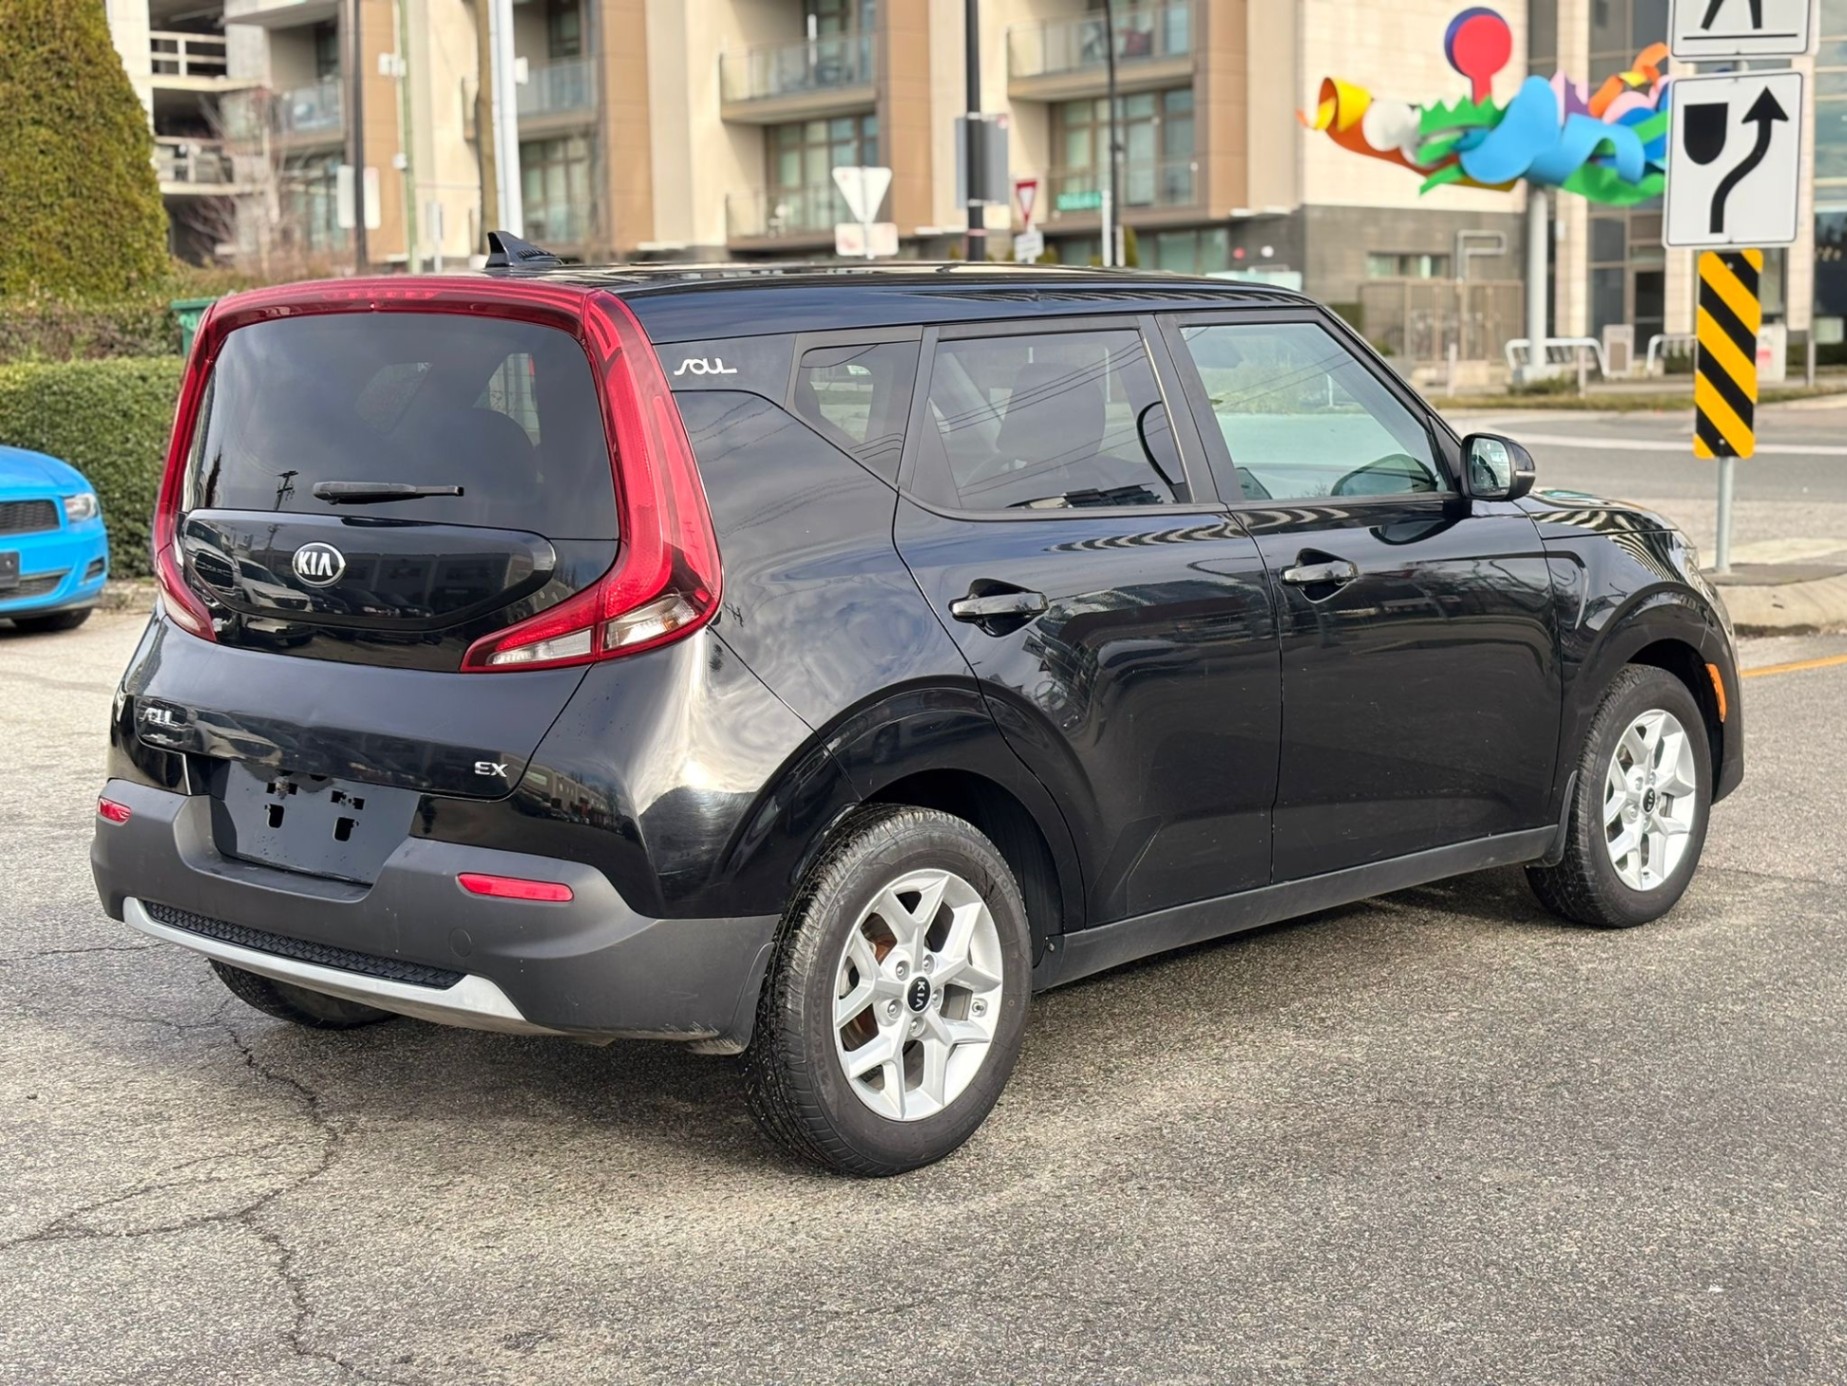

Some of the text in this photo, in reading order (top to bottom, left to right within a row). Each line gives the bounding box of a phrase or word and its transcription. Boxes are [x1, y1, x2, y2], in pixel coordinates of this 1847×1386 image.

[673, 357, 738, 375] SOUL
[298, 551, 333, 577] KIA
[474, 761, 509, 778] EX
[914, 981, 926, 1008] KIA
